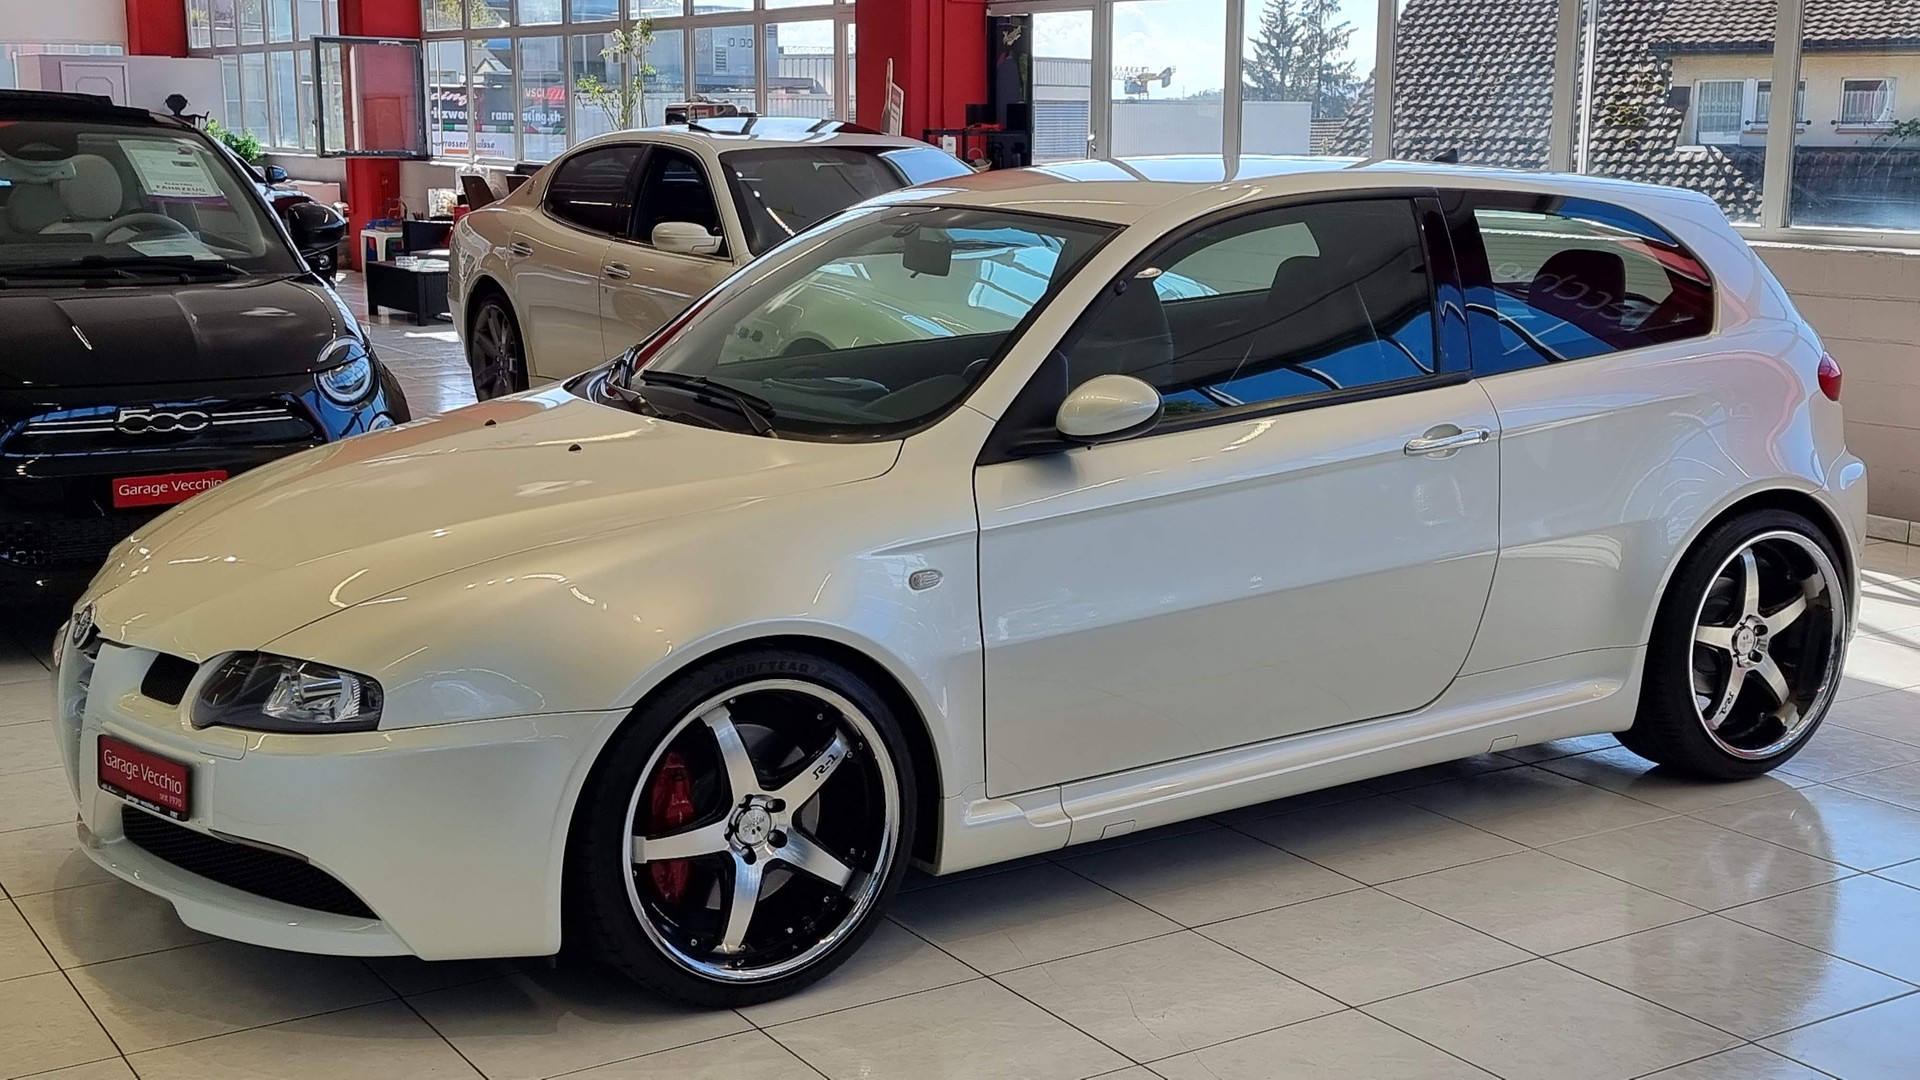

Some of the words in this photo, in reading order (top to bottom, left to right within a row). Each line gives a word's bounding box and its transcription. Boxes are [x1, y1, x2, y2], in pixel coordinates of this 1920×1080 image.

[116, 409, 209, 434] 500
[119, 484, 168, 497] Garage
[103, 749, 139, 780] Garage
[141, 764, 182, 794] Vecchio
[169, 796, 182, 807] 1970
